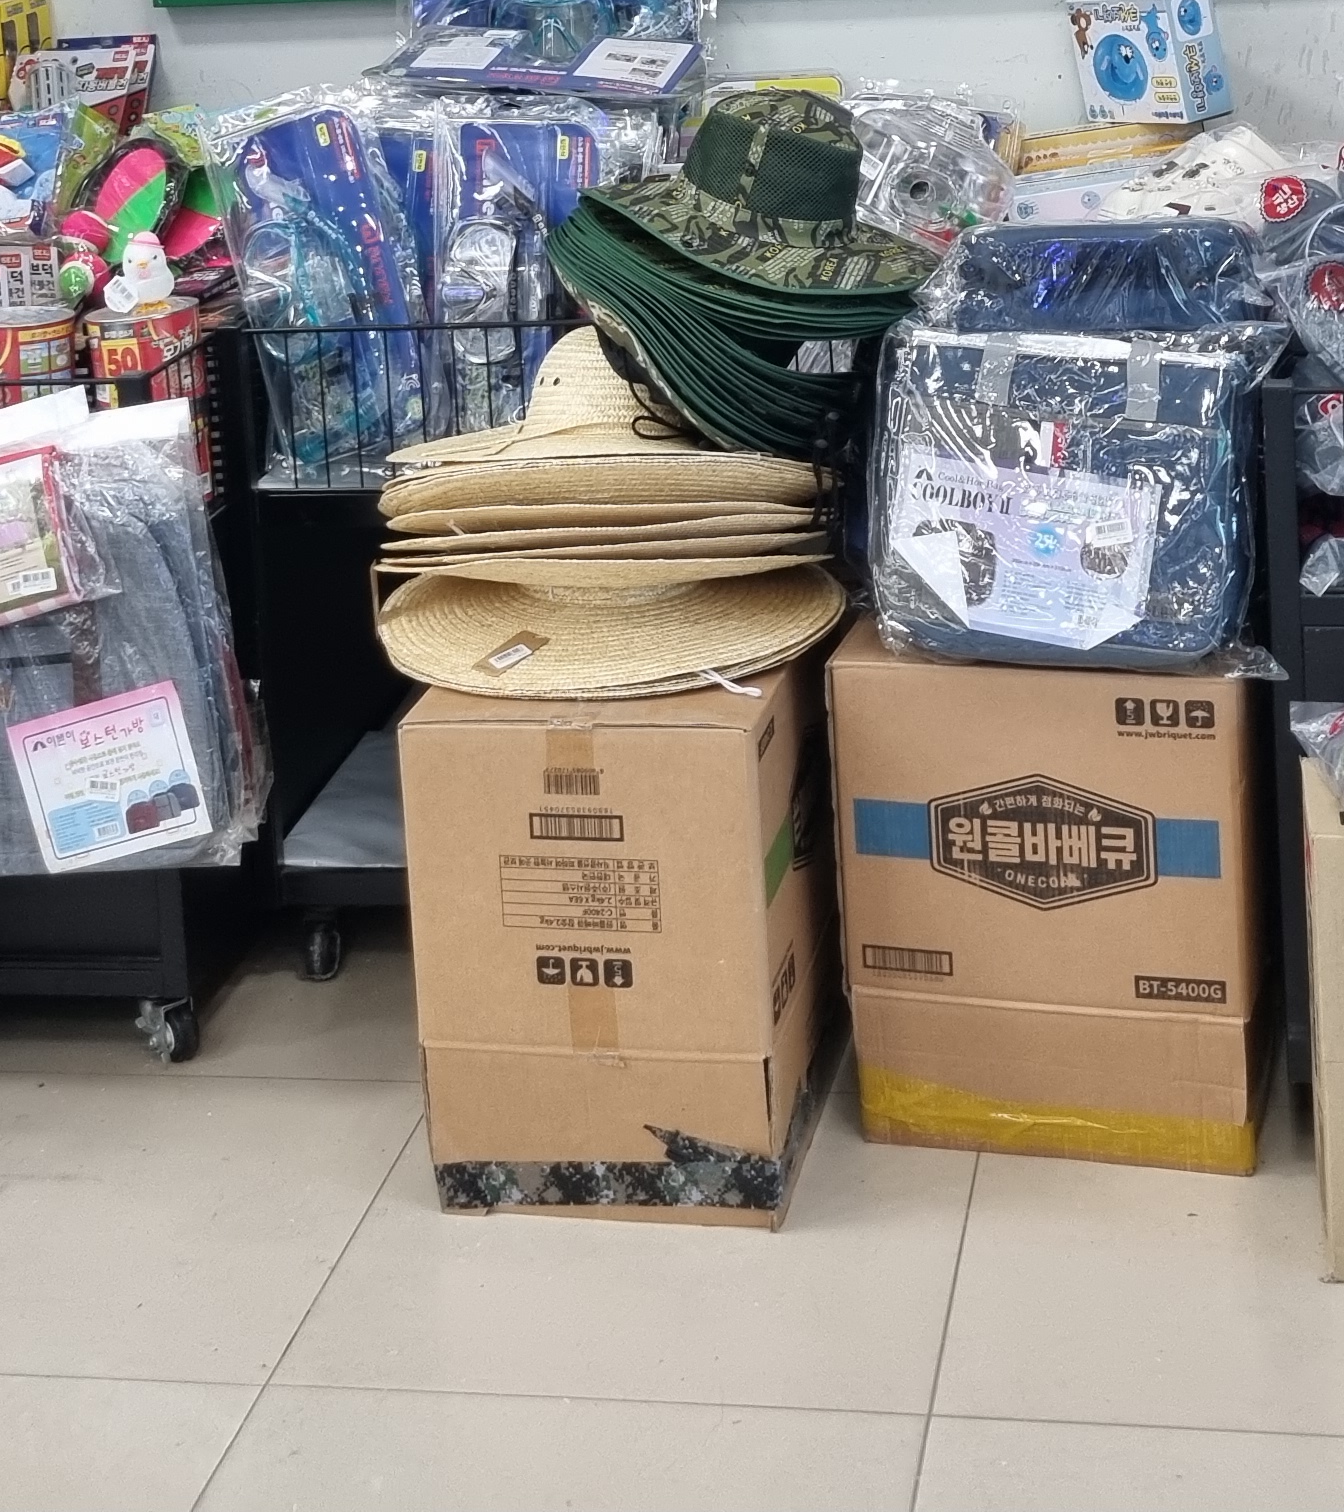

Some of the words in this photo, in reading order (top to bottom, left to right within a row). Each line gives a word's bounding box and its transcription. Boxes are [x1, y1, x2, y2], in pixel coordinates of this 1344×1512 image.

[819, 256, 839, 282] KOREA
[107, 346, 136, 377] 50
[1116, 729, 1217, 741] www.jwbriquet.com
[993, 793, 1038, 810] 간편하게
[1042, 794, 1087, 817] 점화되는
[947, 816, 1138, 870] 원콜바베큐
[535, 943, 632, 955] www.jwbriquet.com
[1138, 979, 1224, 999] BT-5400G
